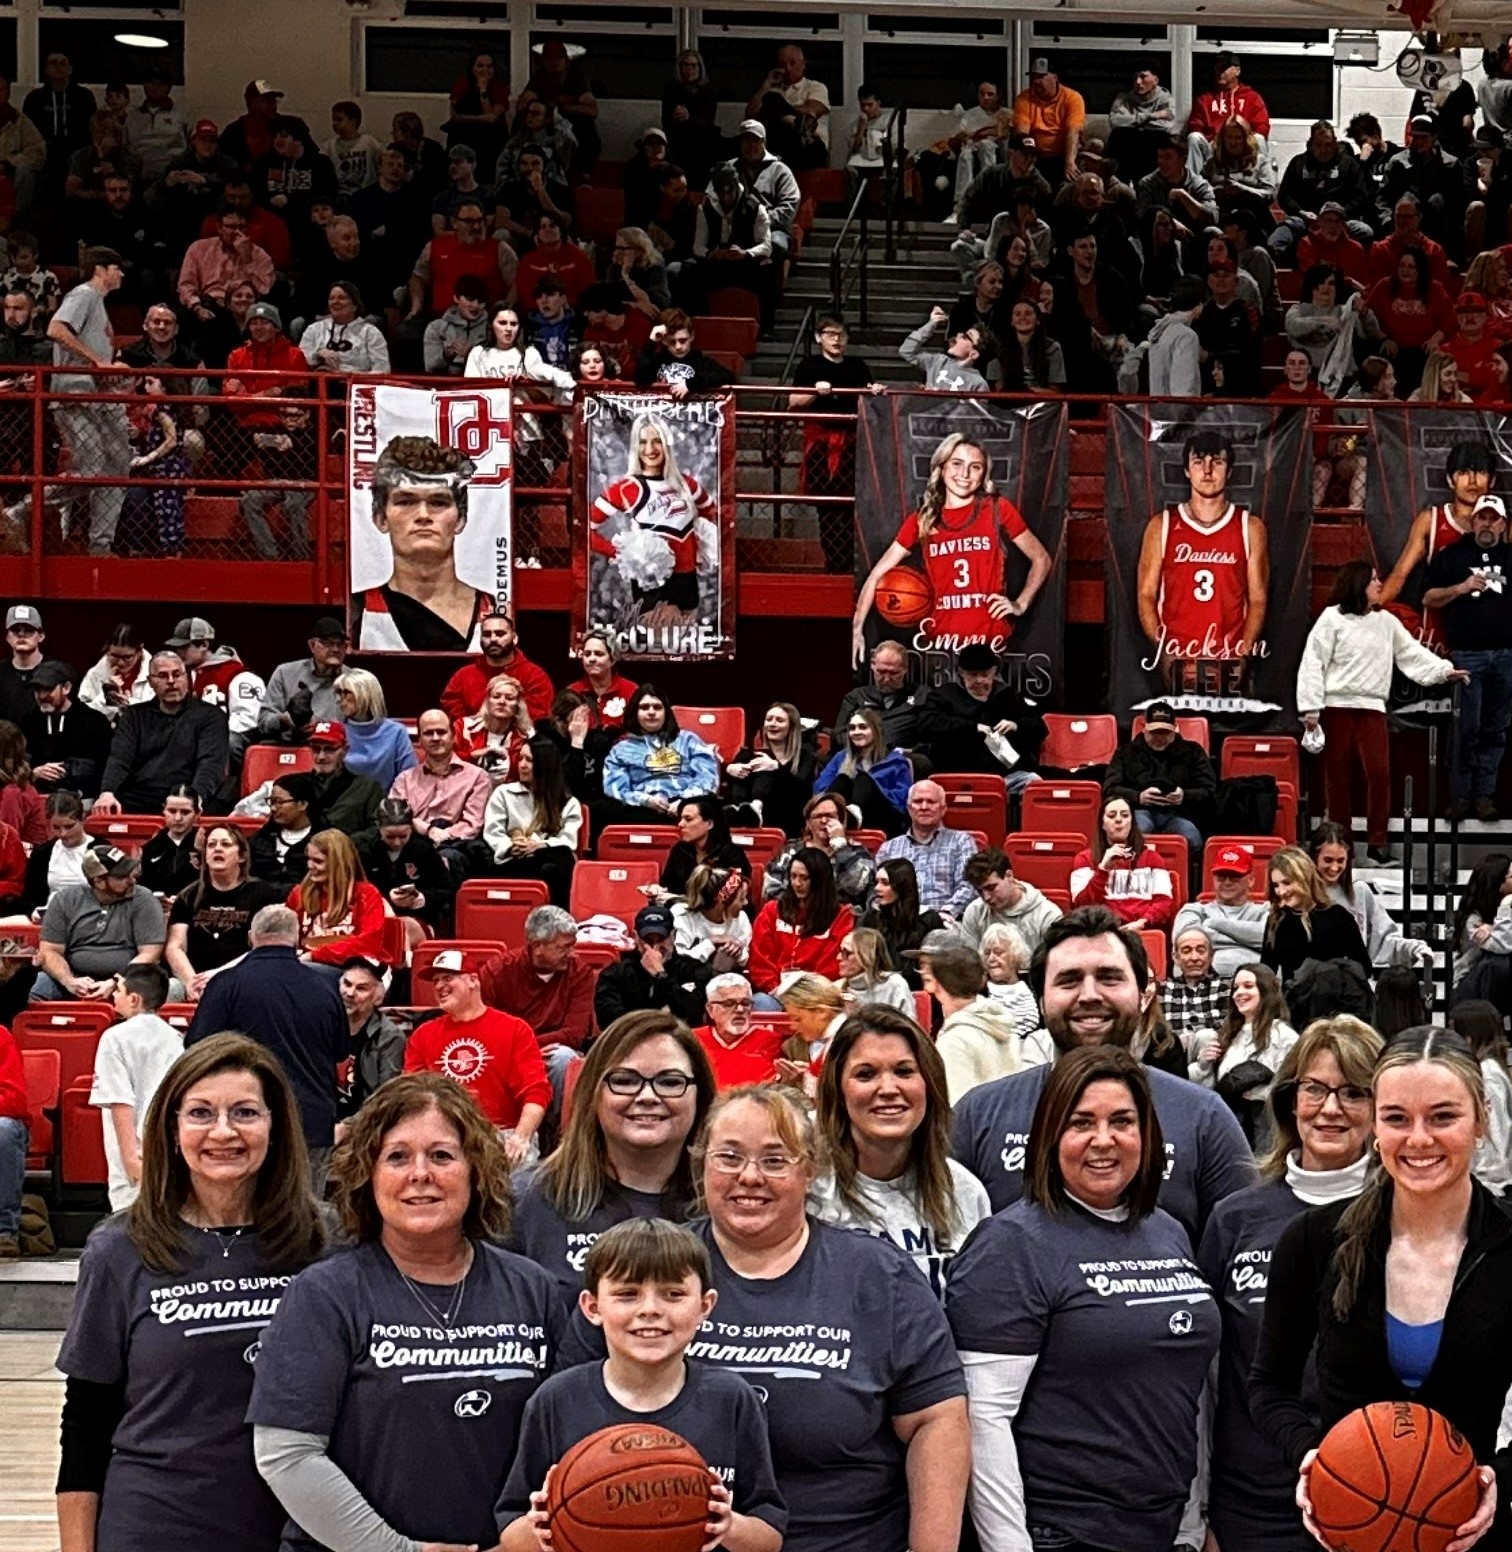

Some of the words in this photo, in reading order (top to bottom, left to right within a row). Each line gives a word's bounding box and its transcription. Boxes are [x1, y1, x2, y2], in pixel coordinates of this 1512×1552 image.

[353, 386, 377, 491] WRESTLING
[929, 535, 992, 558] DAVIESS
[1173, 543, 1237, 565] Daviess
[494, 536, 509, 617] ODEMUS
[953, 558, 970, 589] 3
[1193, 569, 1215, 602] 3
[934, 592, 989, 611] COUNT
[1141, 623, 1271, 671] Jackson
[566, 1232, 603, 1246] PRO
[1233, 1250, 1272, 1264] PROU
[150, 1281, 208, 1303] PROUD
[210, 1279, 236, 1293] TO
[371, 1323, 420, 1339] PROUD
[422, 1325, 445, 1340] TO
[446, 1323, 516, 1341] SUPPORT
[718, 1323, 740, 1336] TO
[742, 1325, 817, 1339] SUPPORT
[816, 1327, 852, 1342] OUR
[684, 1340, 852, 1370] mmunities!
